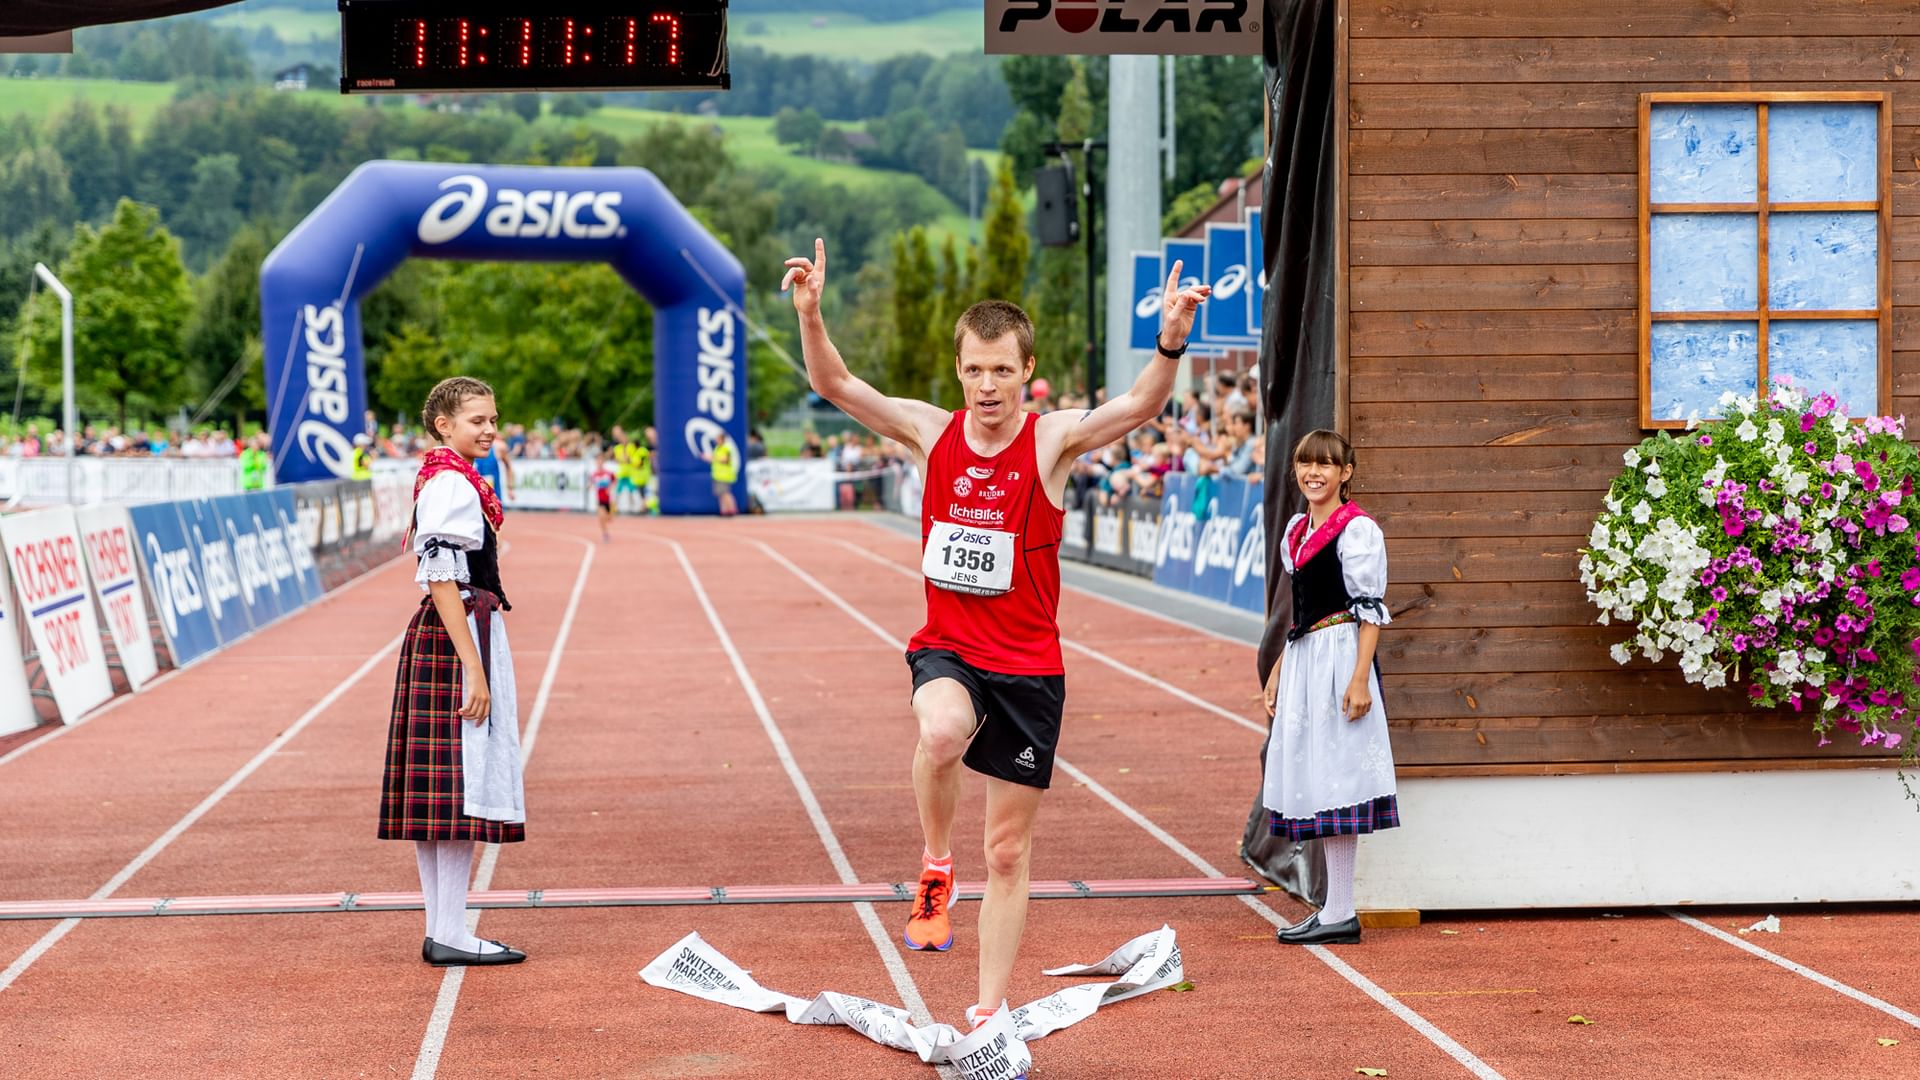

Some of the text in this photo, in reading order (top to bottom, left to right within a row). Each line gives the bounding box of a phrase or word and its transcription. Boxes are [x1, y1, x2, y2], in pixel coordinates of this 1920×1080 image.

[999, 0, 1247, 33] POLAR
[485, 188, 622, 239] asics
[304, 303, 349, 424] asics
[697, 306, 735, 423] asics
[949, 503, 1004, 520] LichtBlick
[963, 532, 992, 546] asics
[942, 545, 996, 573] 1358
[951, 572, 978, 584] JENS
